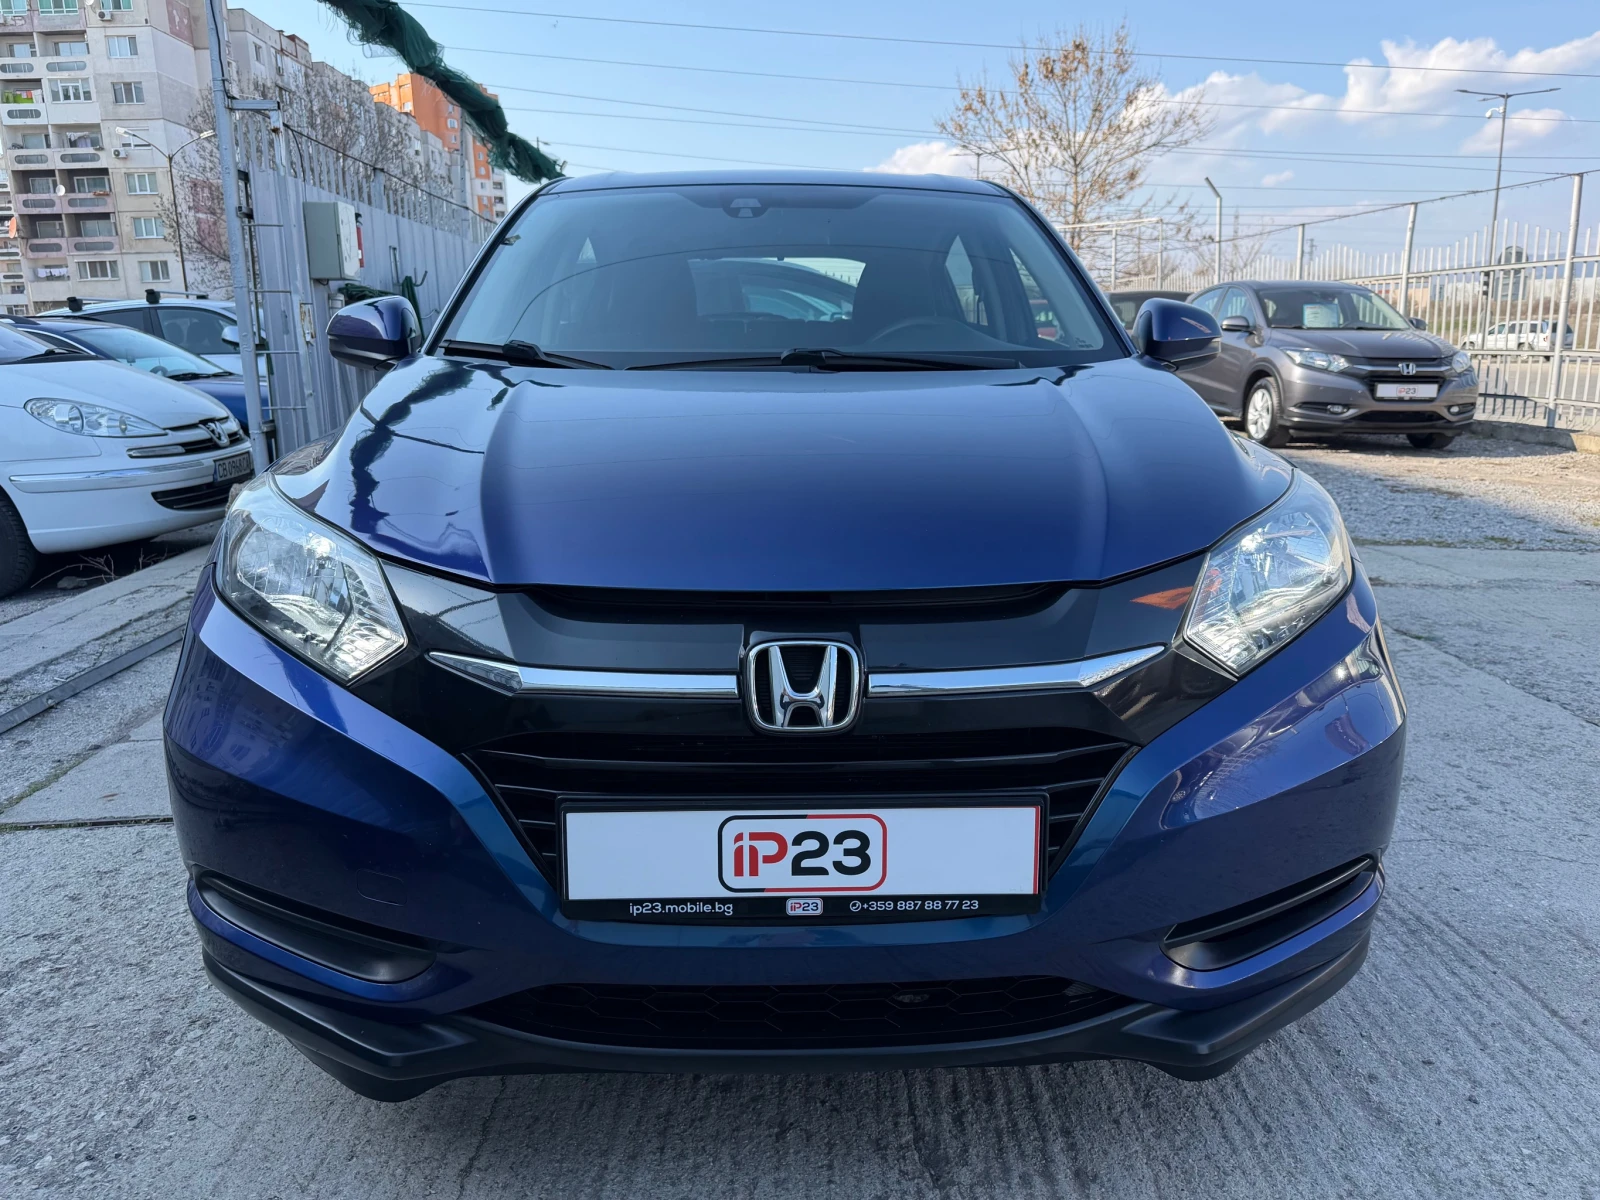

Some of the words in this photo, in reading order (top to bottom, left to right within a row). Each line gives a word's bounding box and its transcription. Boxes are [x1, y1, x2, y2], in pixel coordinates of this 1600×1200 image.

[629, 902, 734, 916] ip23.mobile.bg
[862, 901, 894, 911] +359
[897, 900, 922, 911] 887
[924, 900, 942, 910] 88
[945, 900, 959, 910] 77
[961, 900, 979, 910] 23
